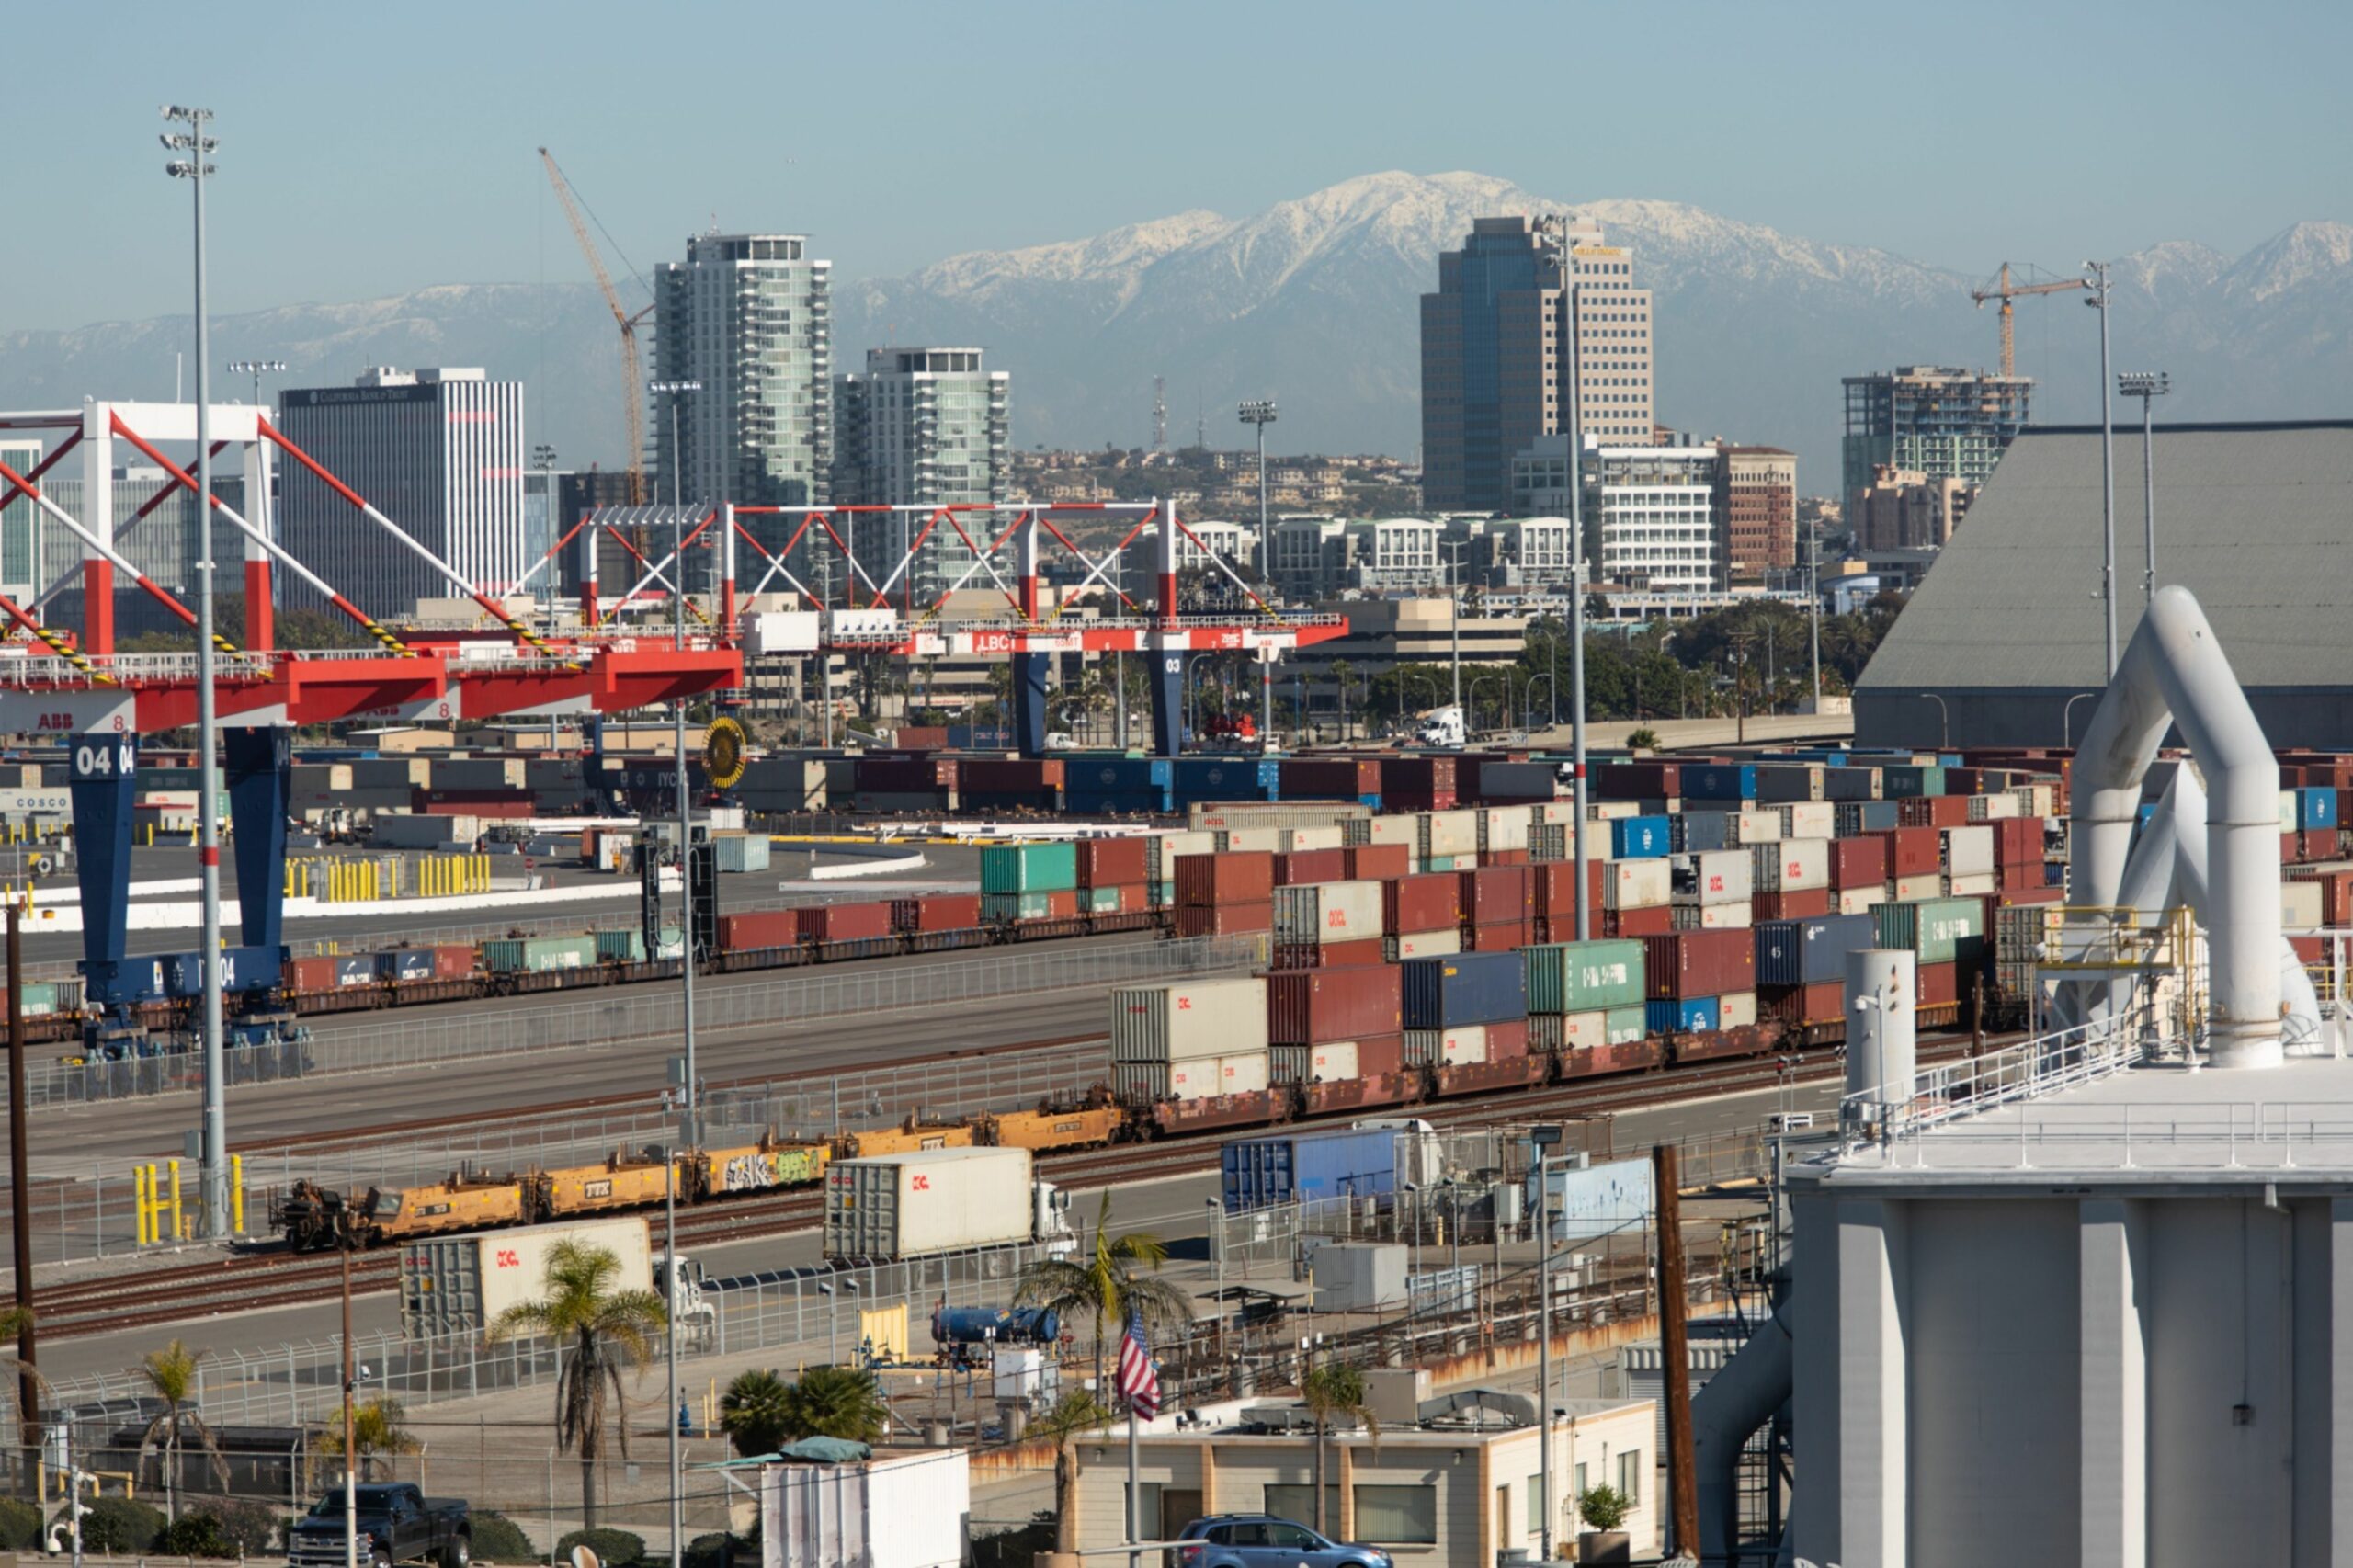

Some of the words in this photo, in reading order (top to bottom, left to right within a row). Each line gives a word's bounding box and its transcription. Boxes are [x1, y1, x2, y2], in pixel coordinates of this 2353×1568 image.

[1165, 658, 1181, 673] 03
[439, 702, 449, 718] 8
[38, 713, 74, 731] ABB
[113, 715, 124, 732] 8
[76, 745, 112, 775] 04
[119, 744, 134, 774] 04
[276, 738, 289, 766] 04
[17, 797, 67, 808] COSCO
[1771, 946, 1781, 959] 45
[585, 1182, 610, 1197] TTX
